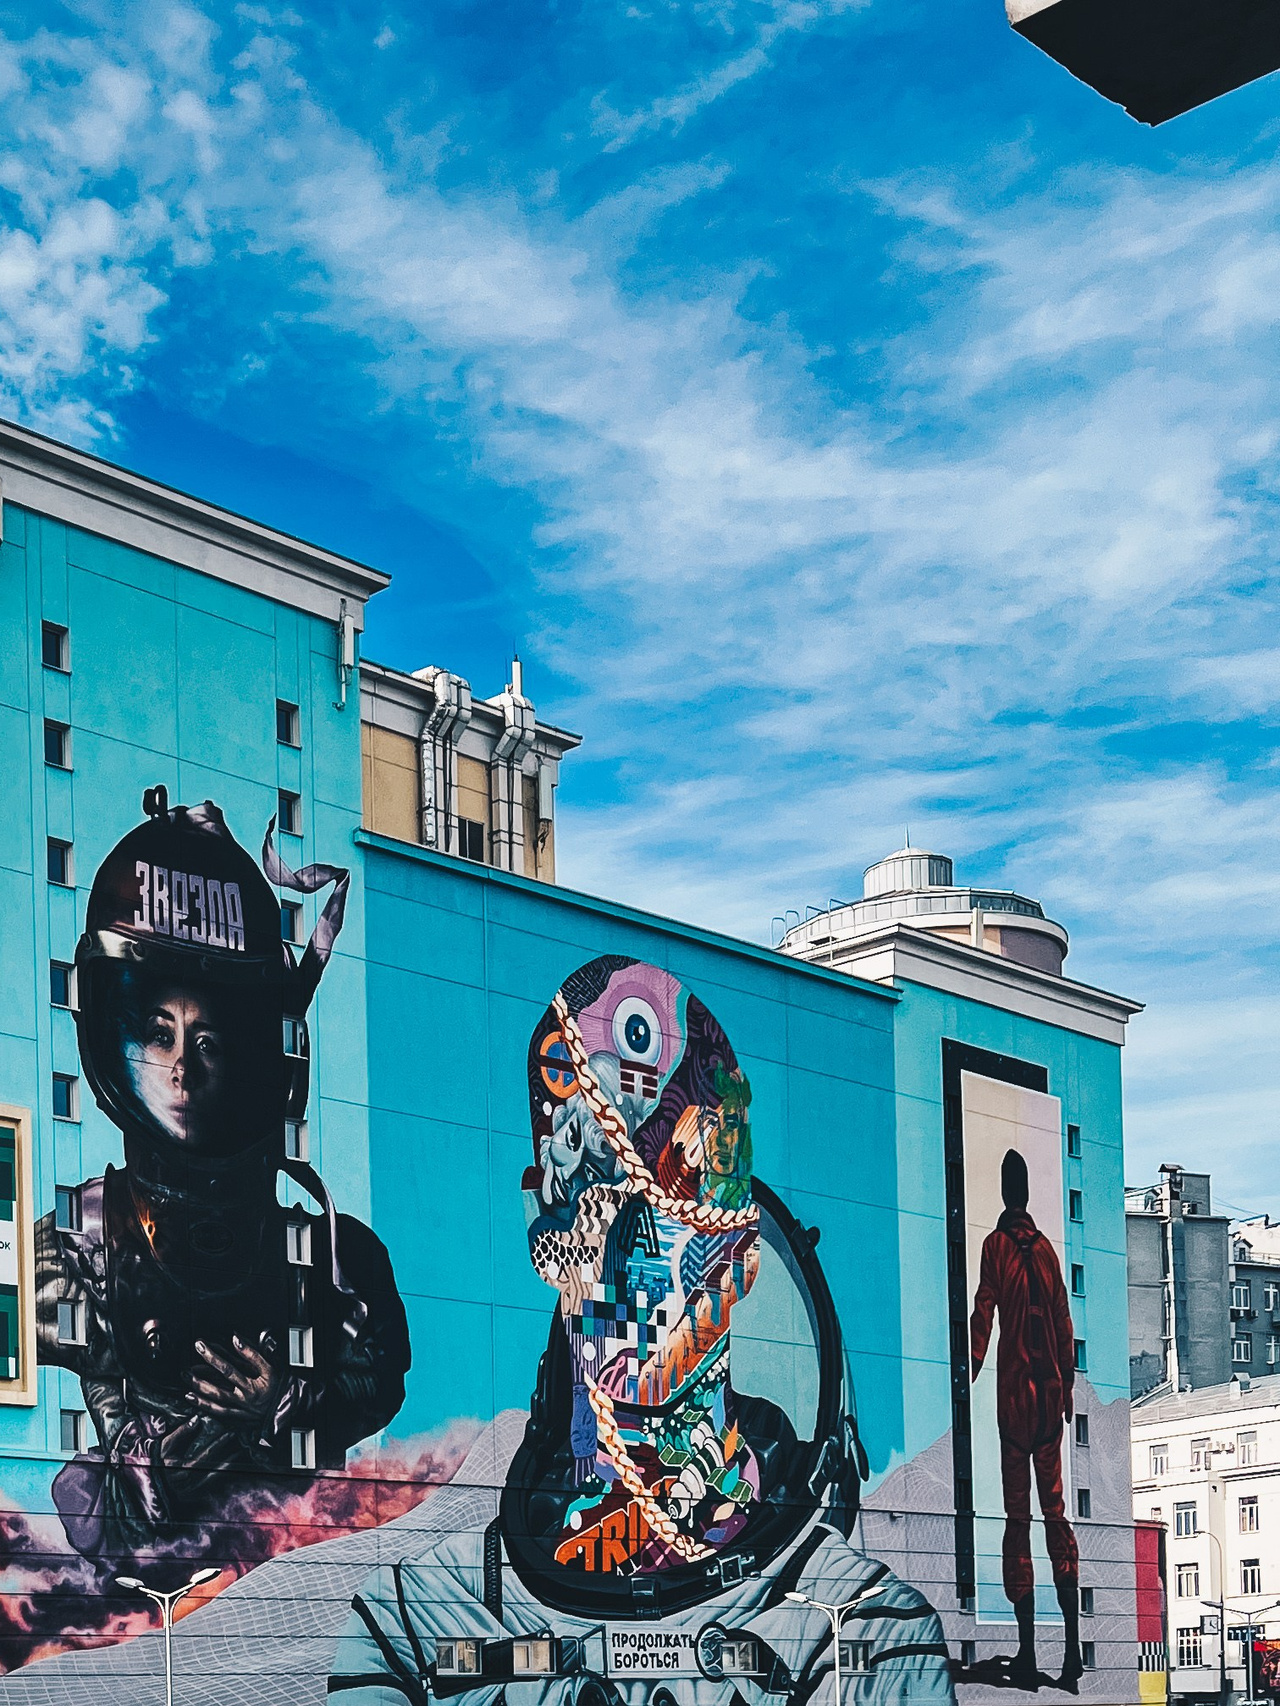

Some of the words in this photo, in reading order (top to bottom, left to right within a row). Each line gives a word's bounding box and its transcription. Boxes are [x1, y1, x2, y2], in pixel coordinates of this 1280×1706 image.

[134, 860, 246, 952] ЗВЕЗДА
[611, 1632, 696, 1652] ПРОДОЛЖАТЬ
[613, 1651, 680, 1670] БОРОТЬСЯ
